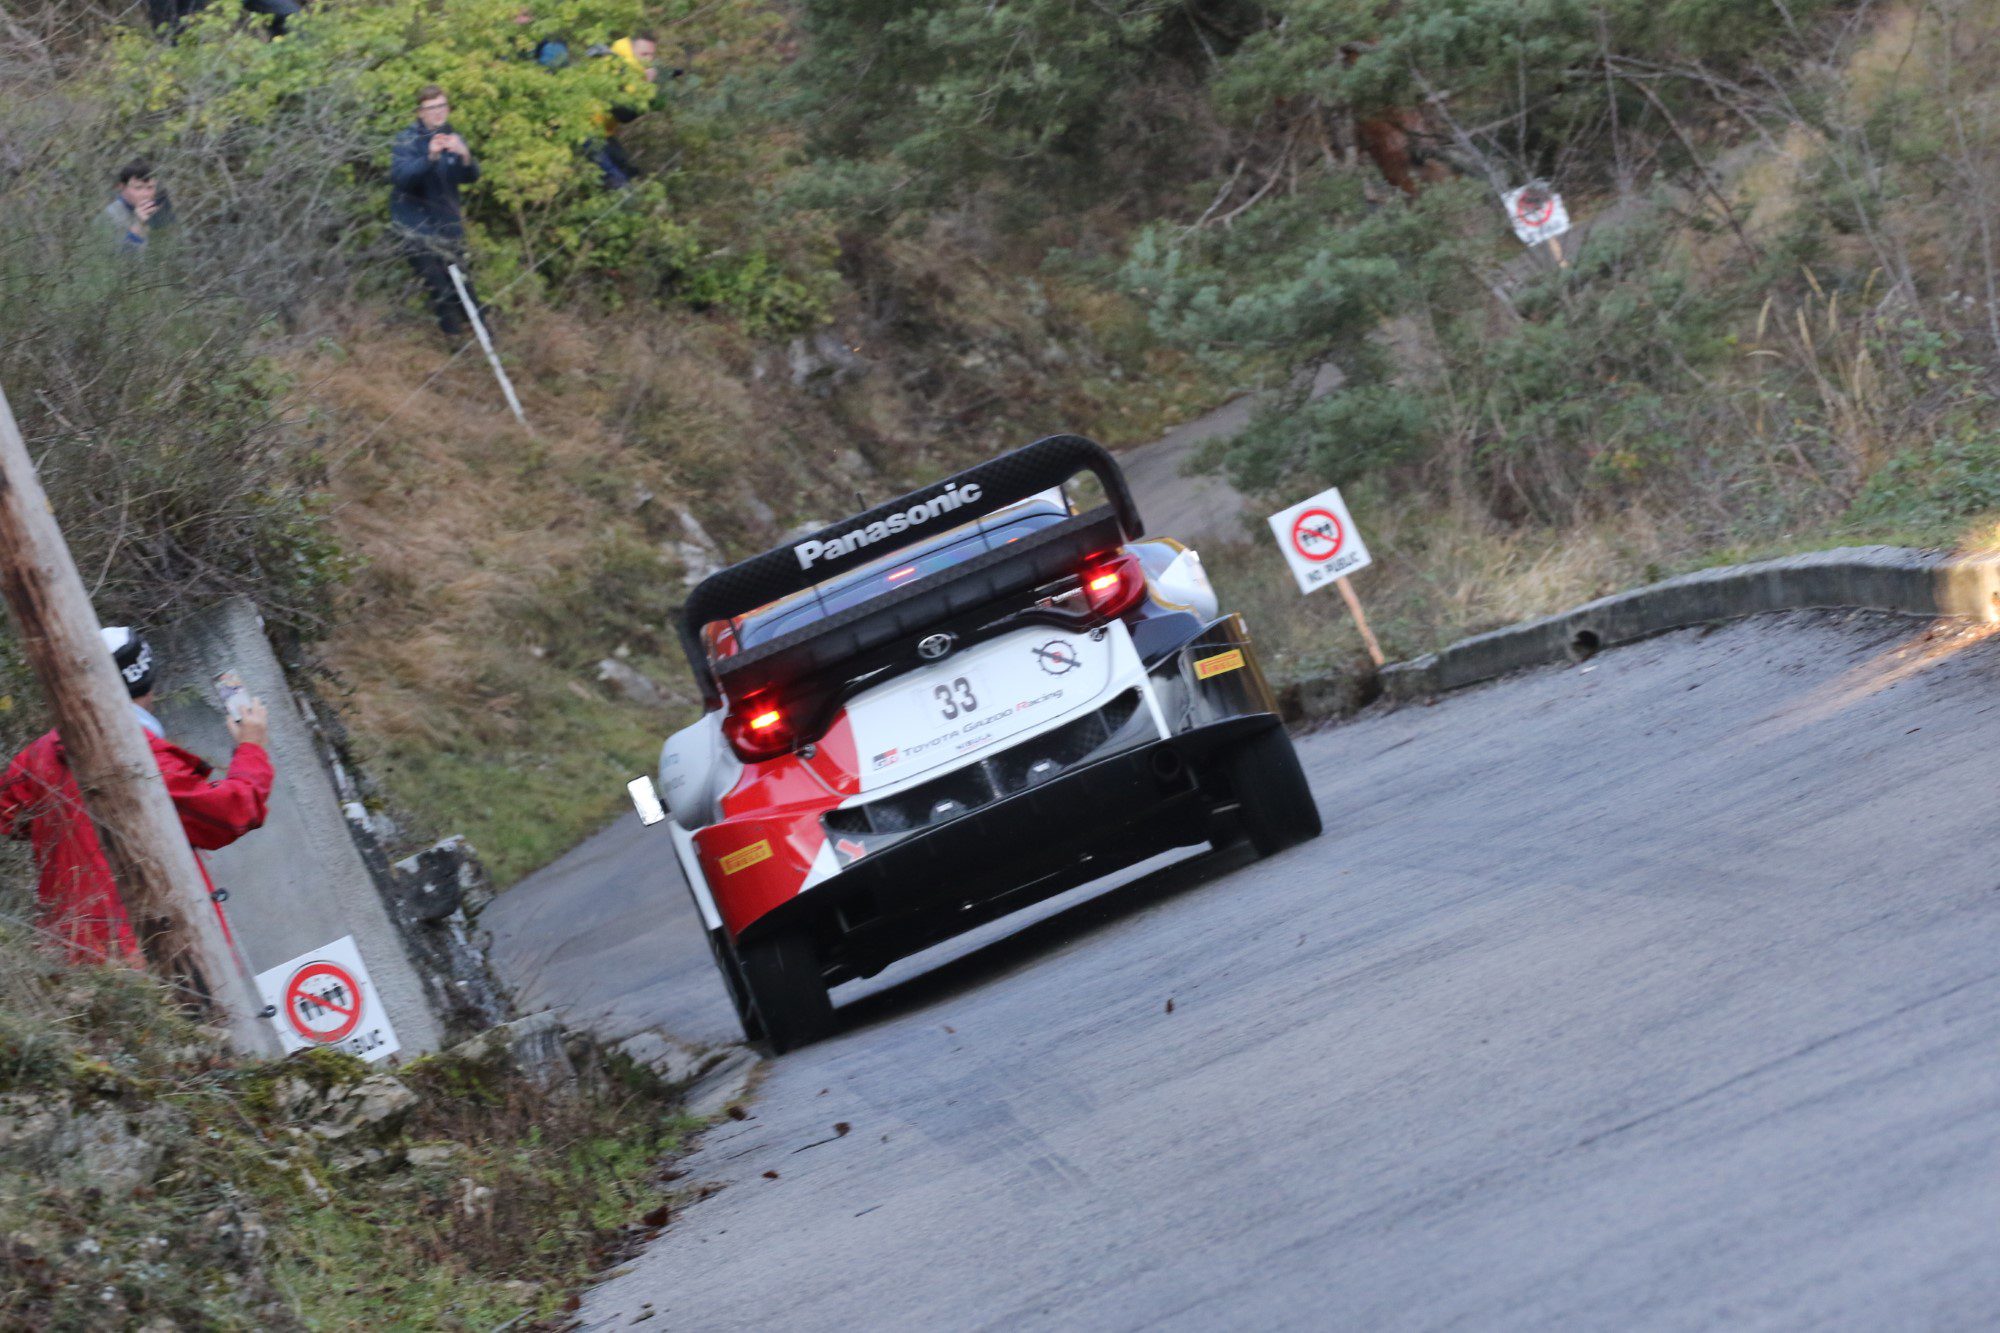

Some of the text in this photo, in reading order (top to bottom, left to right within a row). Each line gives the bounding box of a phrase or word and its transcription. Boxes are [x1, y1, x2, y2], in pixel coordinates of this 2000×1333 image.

[794, 483, 983, 571] Panasonic
[902, 730, 959, 756] TOYOTA
[1015, 689, 1064, 712] Racing
[935, 677, 978, 720] 33
